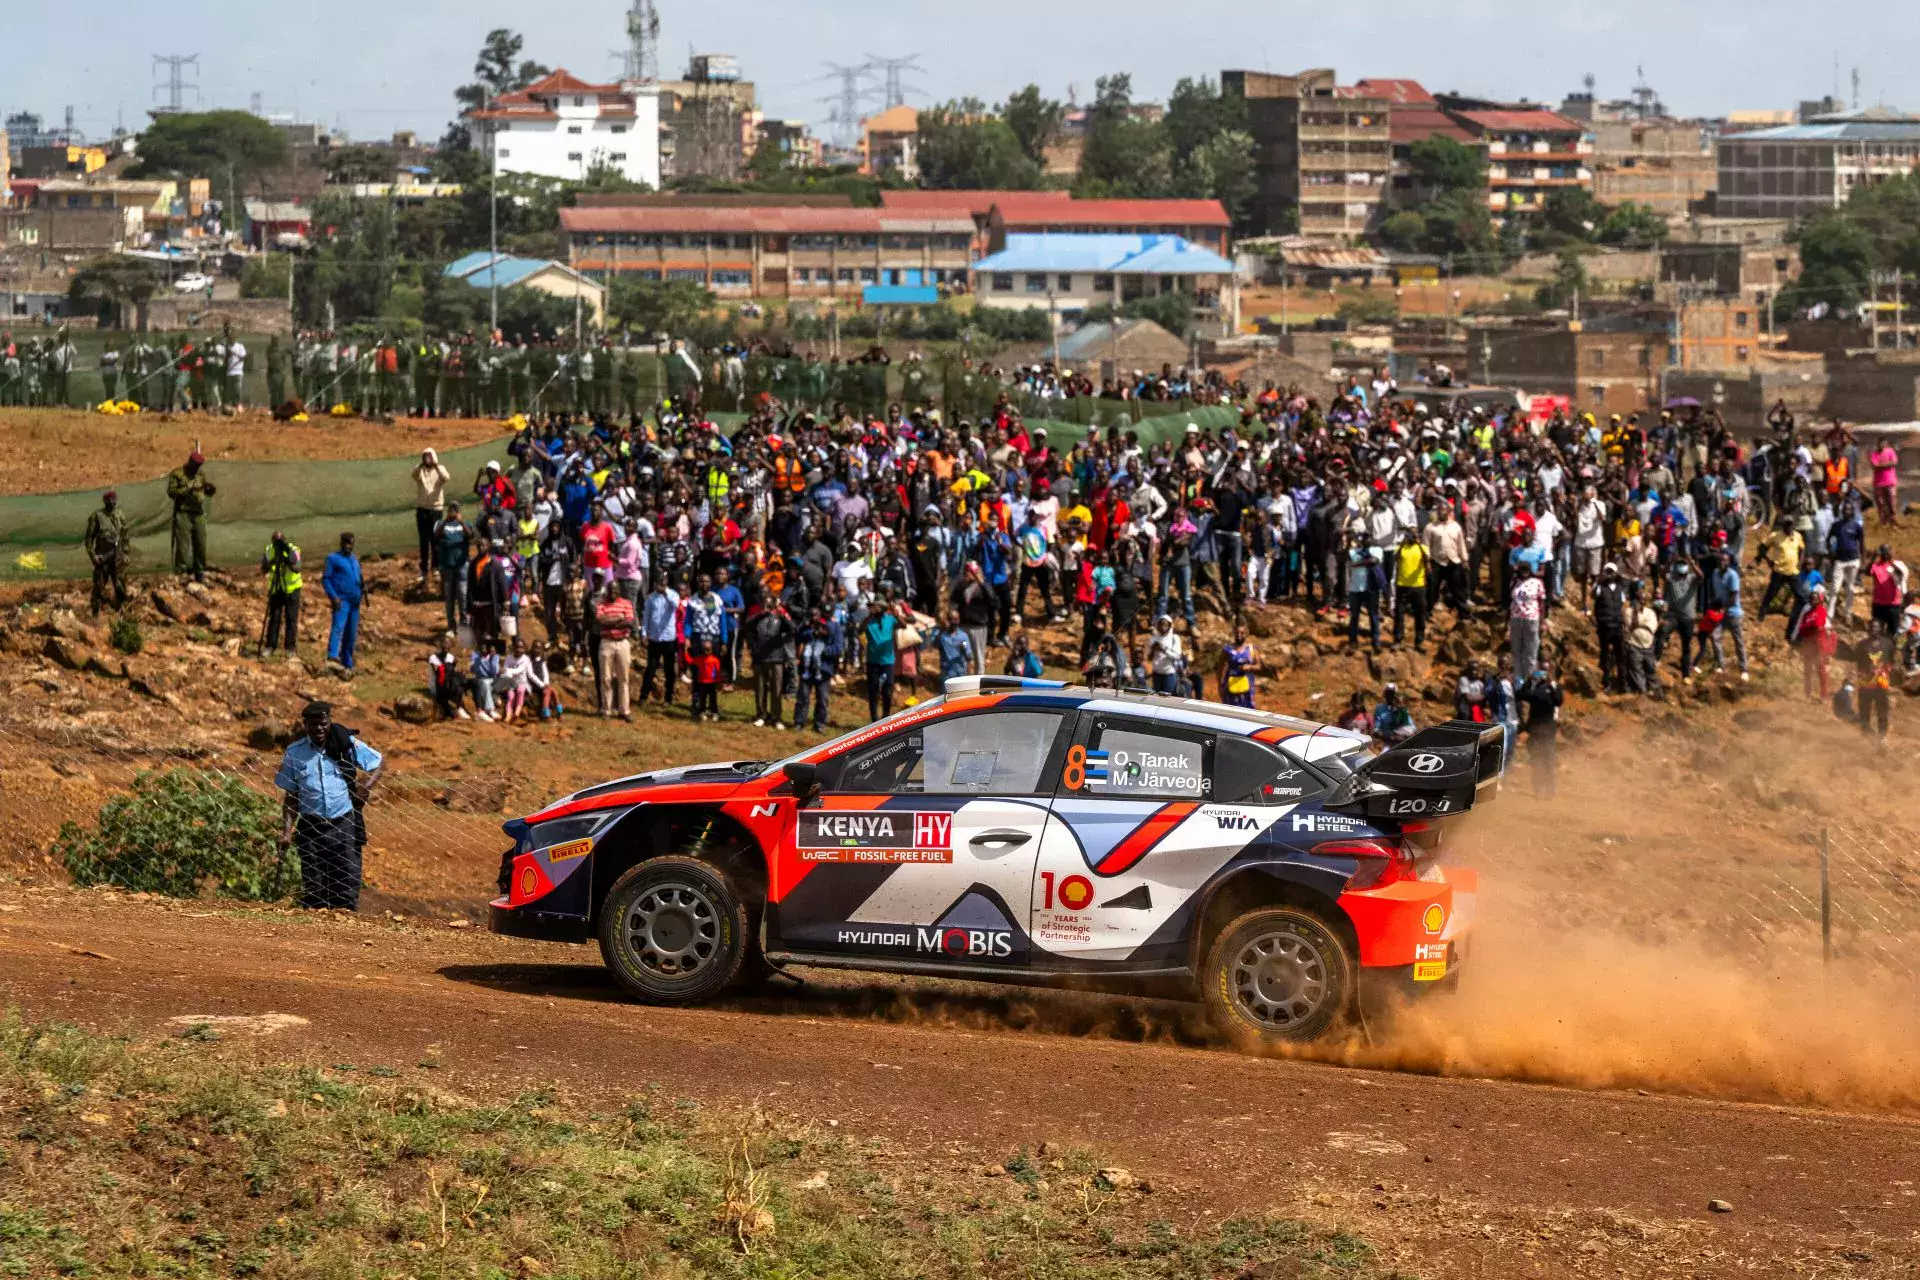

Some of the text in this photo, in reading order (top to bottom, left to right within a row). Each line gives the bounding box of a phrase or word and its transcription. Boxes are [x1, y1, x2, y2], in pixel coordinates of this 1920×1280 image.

[828, 706, 944, 755] motorsport.hyundai.com
[873, 741, 906, 763] HYUNDAI
[1114, 751, 1189, 769] O. Tanak
[1063, 744, 1087, 790] 8
[1112, 770, 1212, 792] M. Järveoja
[818, 816, 894, 837] KENYA
[1317, 815, 1367, 826] HYUNDAI
[1317, 824, 1354, 833] STEEL
[917, 815, 950, 846] HY
[551, 841, 589, 860] PIRELLI
[802, 852, 839, 861] WRC
[854, 851, 946, 862] FOSSIL-FREE FUEL
[1040, 930, 1091, 942] Partnership
[1041, 922, 1051, 930] of
[1052, 922, 1091, 934] Strategic
[838, 928, 1011, 957] HYUNDAI MOBIS
